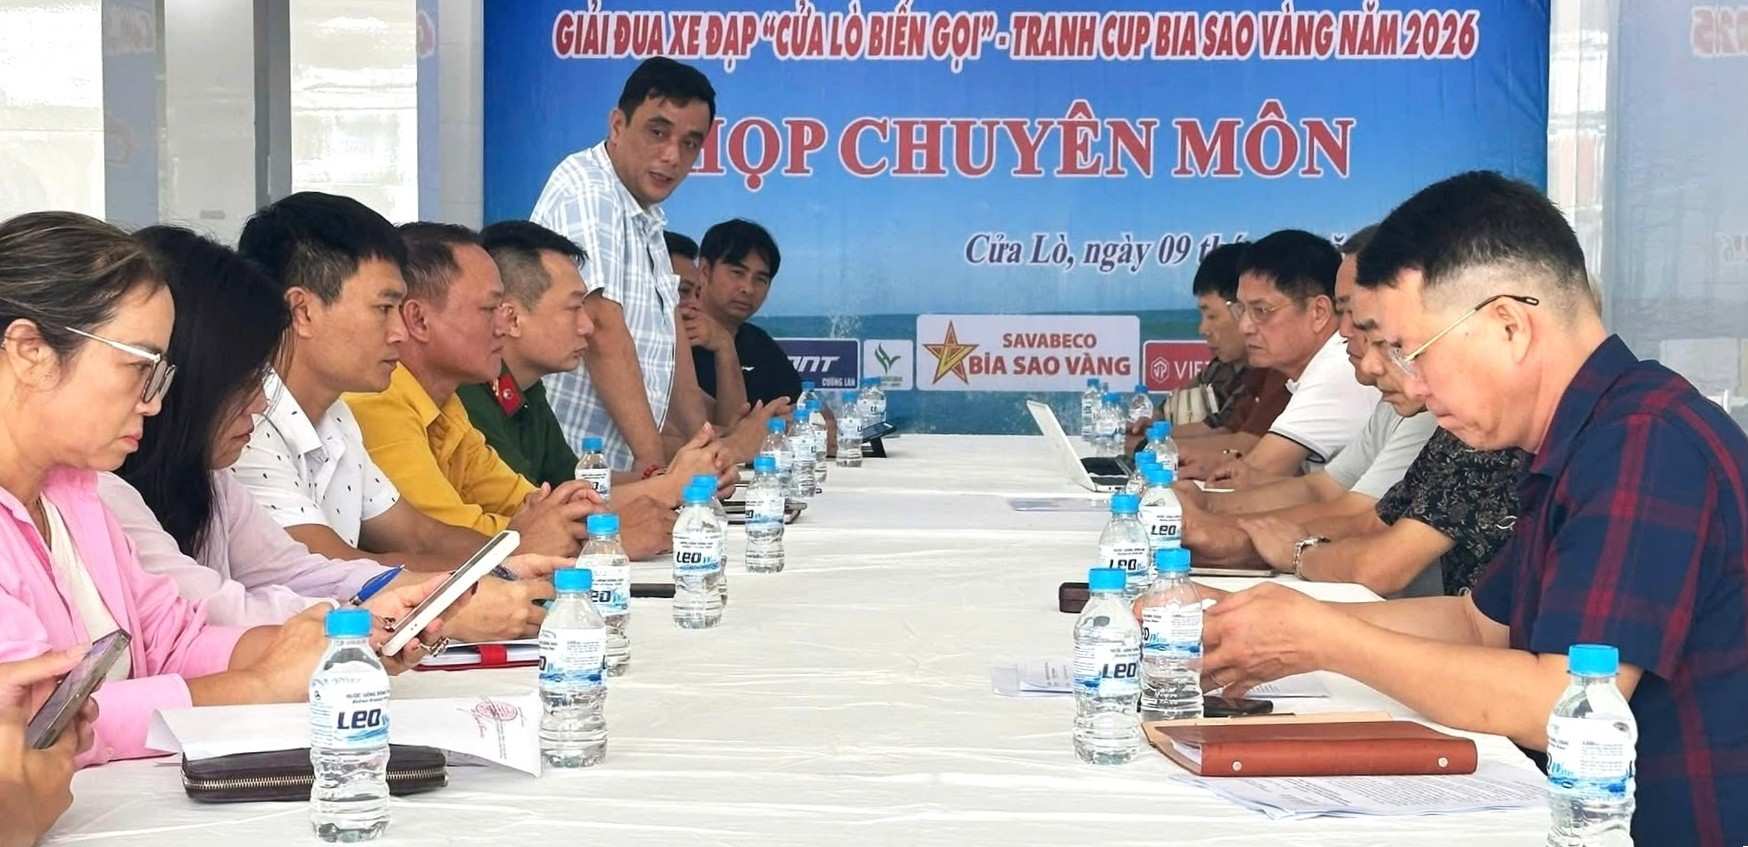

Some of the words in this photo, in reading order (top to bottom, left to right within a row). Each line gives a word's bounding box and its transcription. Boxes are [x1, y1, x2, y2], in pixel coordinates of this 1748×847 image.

[557, 0, 610, 54] GIẢI
[613, 15, 664, 55] ĐUA
[670, 15, 701, 55] XE
[706, 15, 758, 66] ĐẠP
[830, 2, 863, 56] LÒ
[1013, 15, 1096, 56] TRANH
[1101, 16, 1152, 56] CUP
[1156, 15, 1196, 56] BIA
[1203, 15, 1255, 56] SAO
[1261, 2, 1333, 55] VÀNG
[1339, 1, 1398, 55] NĂM
[1406, 15, 1475, 56] 2026
[840, 102, 1155, 175] CHUYÊN
[1175, 101, 1354, 175] MÔN
[966, 233, 1022, 264] Cửa
[1084, 234, 1151, 272] ngày
[1157, 234, 1192, 264] 09
[1002, 332, 1098, 349] SAVABECO
[1013, 356, 1064, 376] SAO
[1065, 352, 1131, 376] VÀNG
